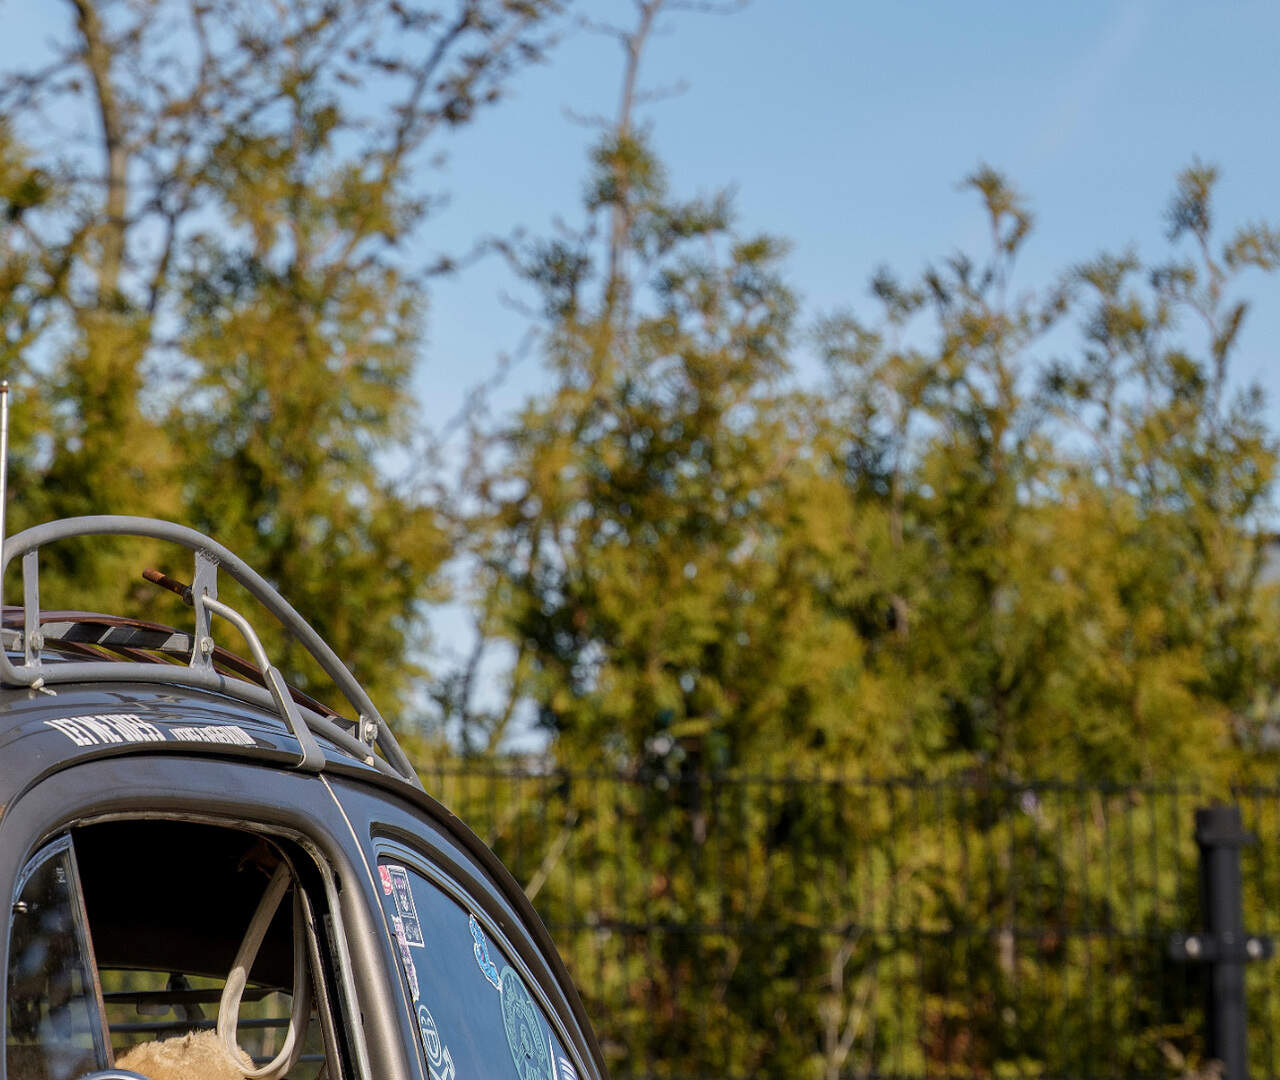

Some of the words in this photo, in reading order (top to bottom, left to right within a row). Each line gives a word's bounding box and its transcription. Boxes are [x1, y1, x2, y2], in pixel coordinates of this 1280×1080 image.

[43, 717, 102, 746] LET
[70, 715, 124, 744] ME
[95, 713, 167, 742] GUESS
